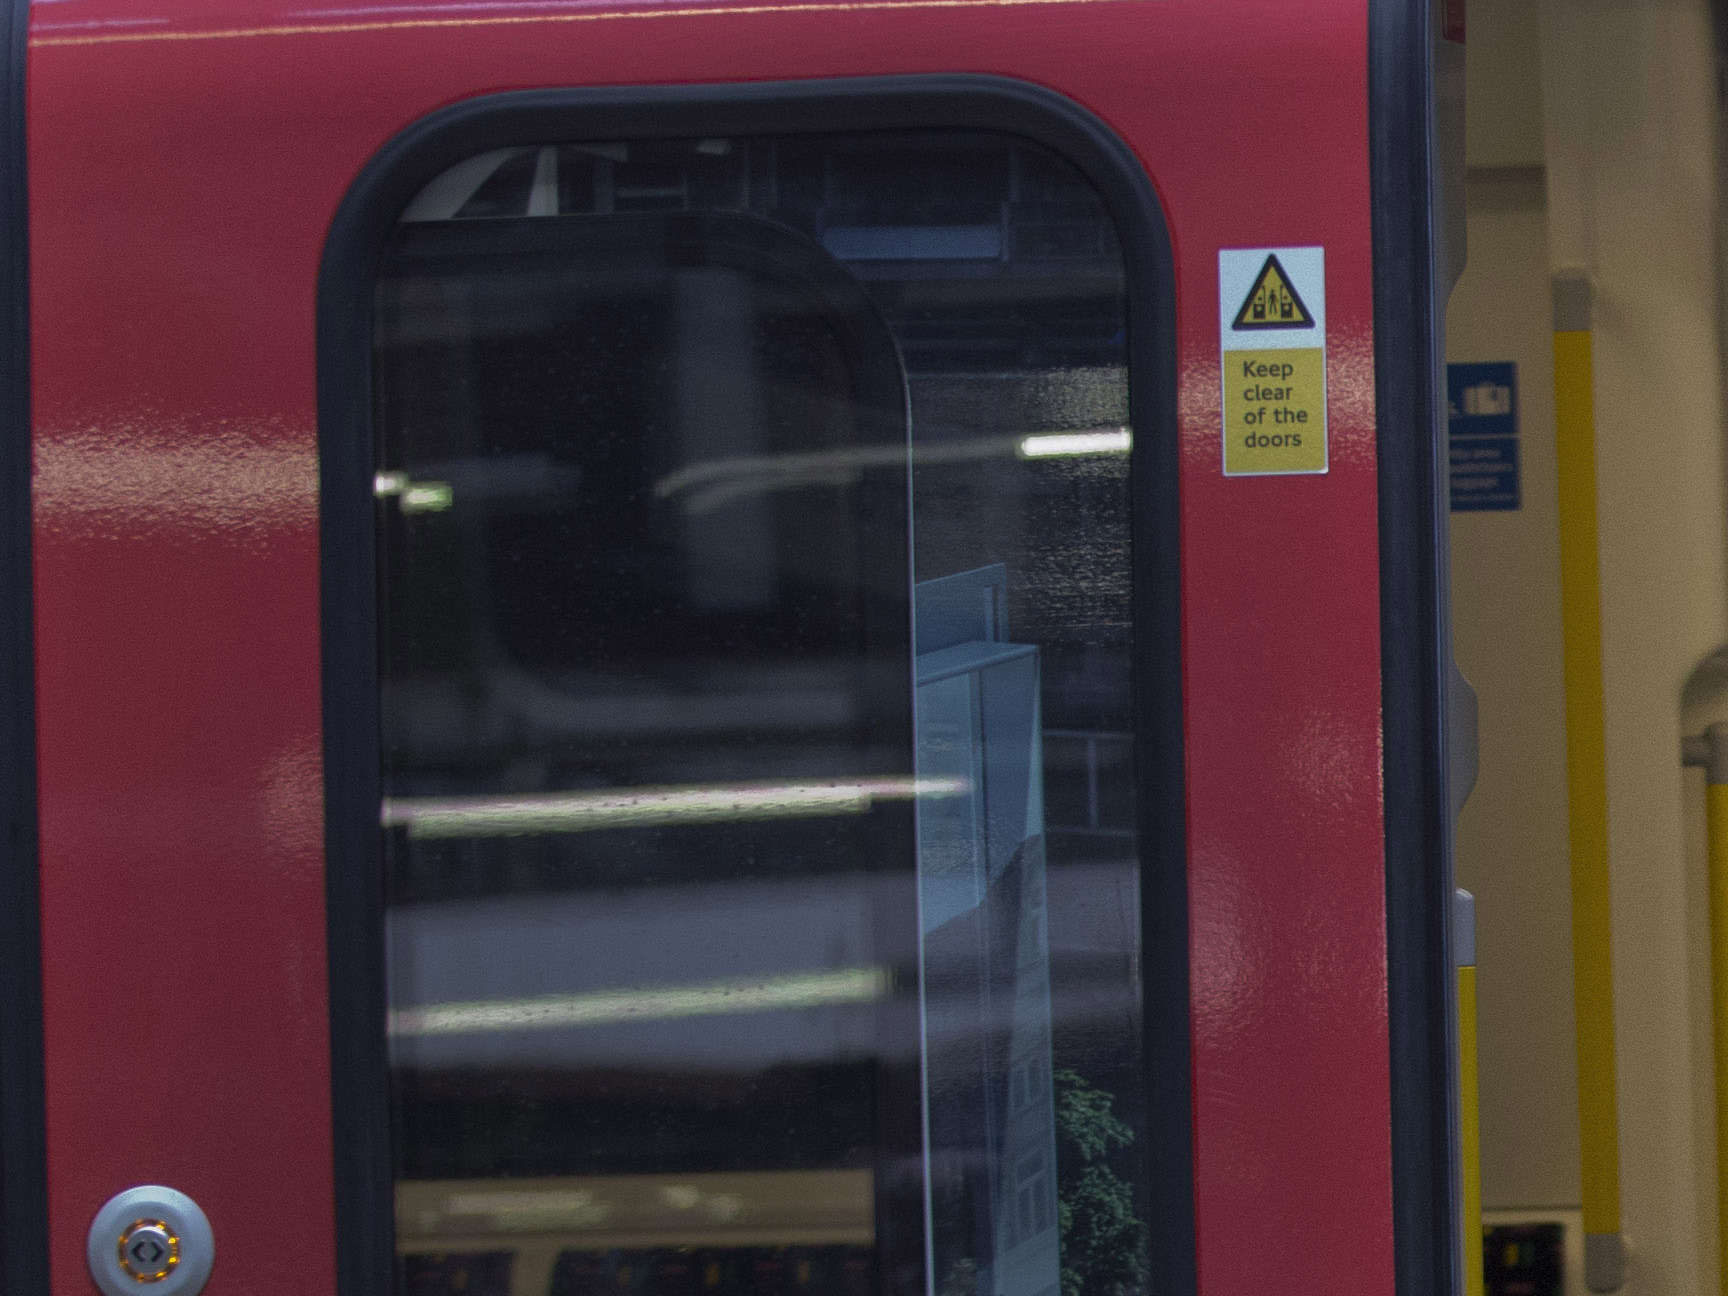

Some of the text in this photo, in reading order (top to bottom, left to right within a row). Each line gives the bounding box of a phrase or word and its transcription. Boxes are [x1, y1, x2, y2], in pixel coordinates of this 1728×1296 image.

[1243, 361, 1294, 382] Keep
[1243, 384, 1292, 402] clear
[1244, 406, 1309, 425] of the
[1244, 431, 1303, 449] doors
